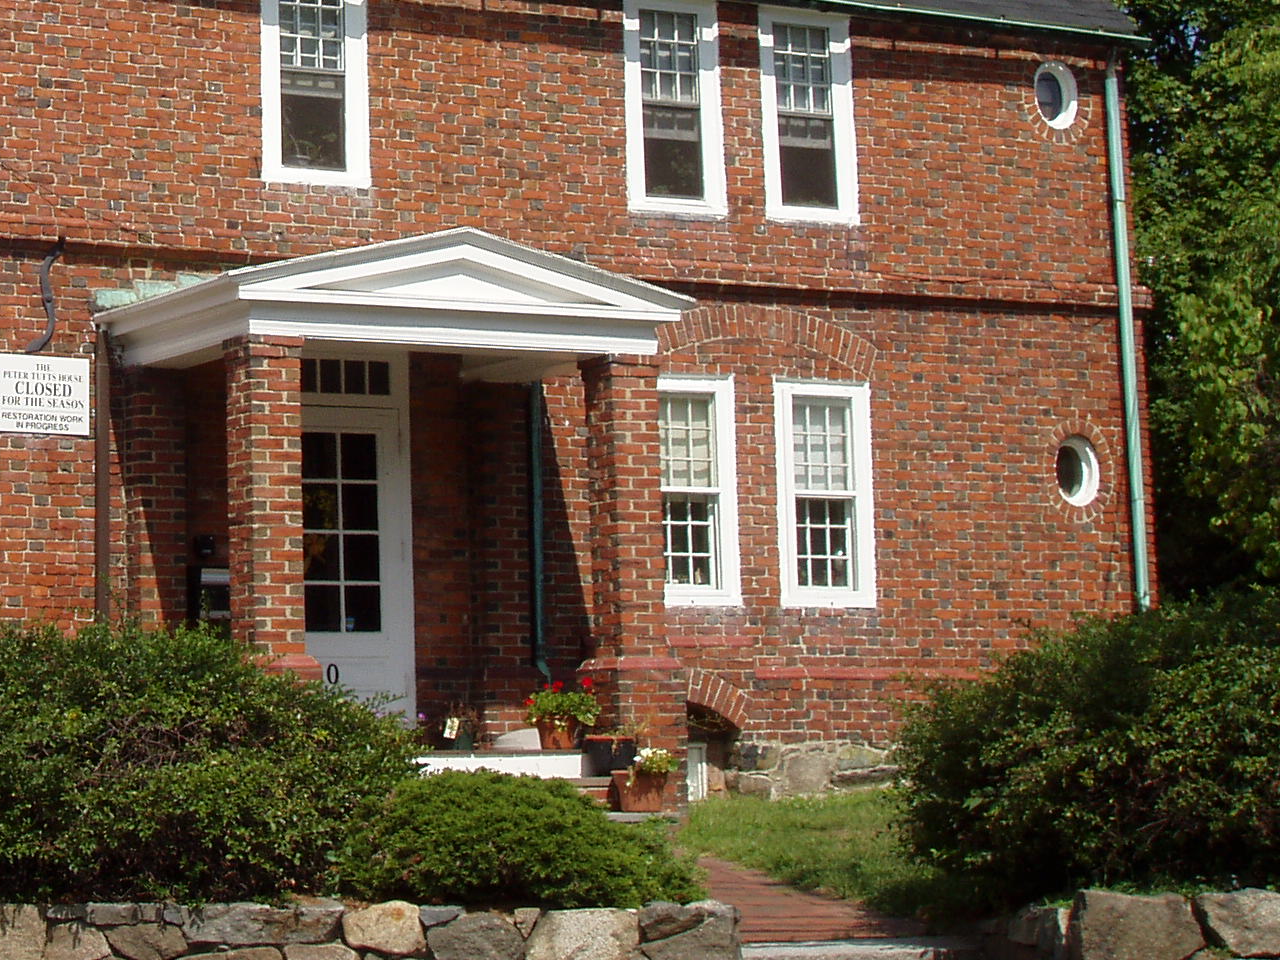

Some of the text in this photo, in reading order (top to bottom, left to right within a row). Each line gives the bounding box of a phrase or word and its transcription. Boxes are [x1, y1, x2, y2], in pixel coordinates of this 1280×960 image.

[3, 371, 82, 382] PETER TUFTS HOUSE
[15, 381, 72, 397] CLOSED
[2, 396, 84, 408] FOR THE SEASON
[2, 412, 57, 422] RESTORATION
[26, 422, 70, 431] PROGRESS
